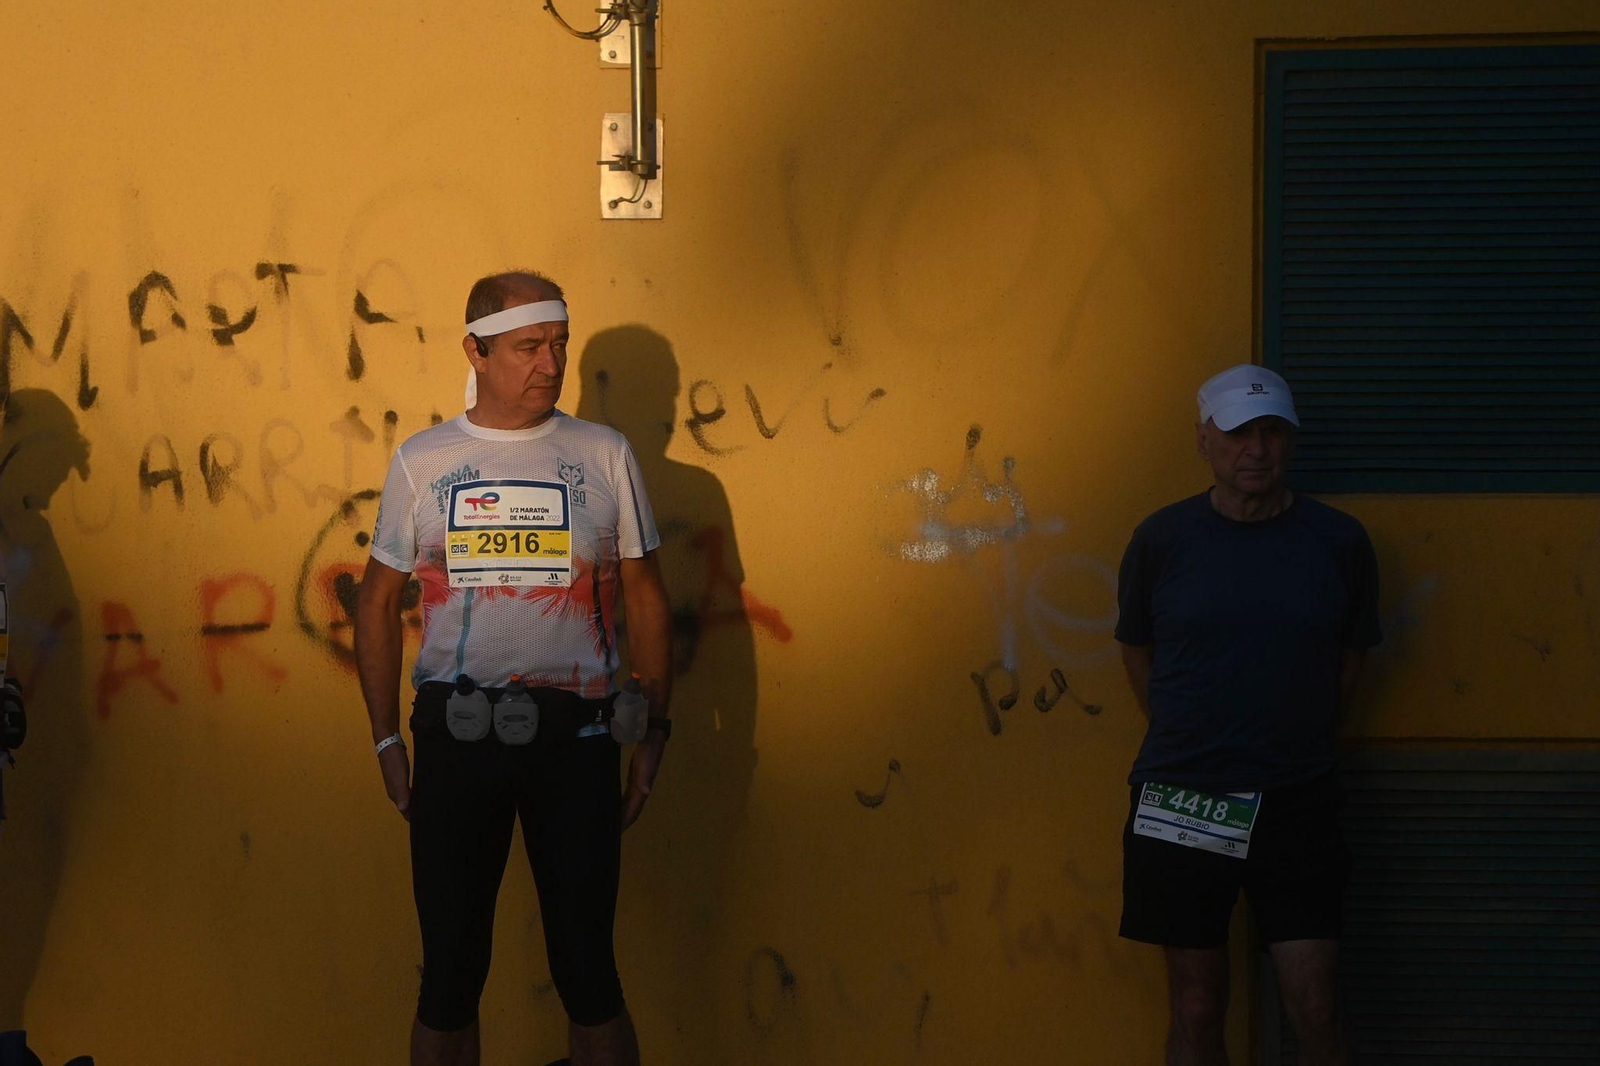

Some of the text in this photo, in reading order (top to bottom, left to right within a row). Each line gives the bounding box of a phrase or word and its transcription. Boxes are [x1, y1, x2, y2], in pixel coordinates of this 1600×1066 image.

[519, 513, 545, 521] MÁLAGA
[520, 505, 550, 514] MARATÓN
[477, 532, 540, 554] 2916
[1168, 789, 1229, 822] 4418
[1173, 815, 1210, 830] JO RUBIO
